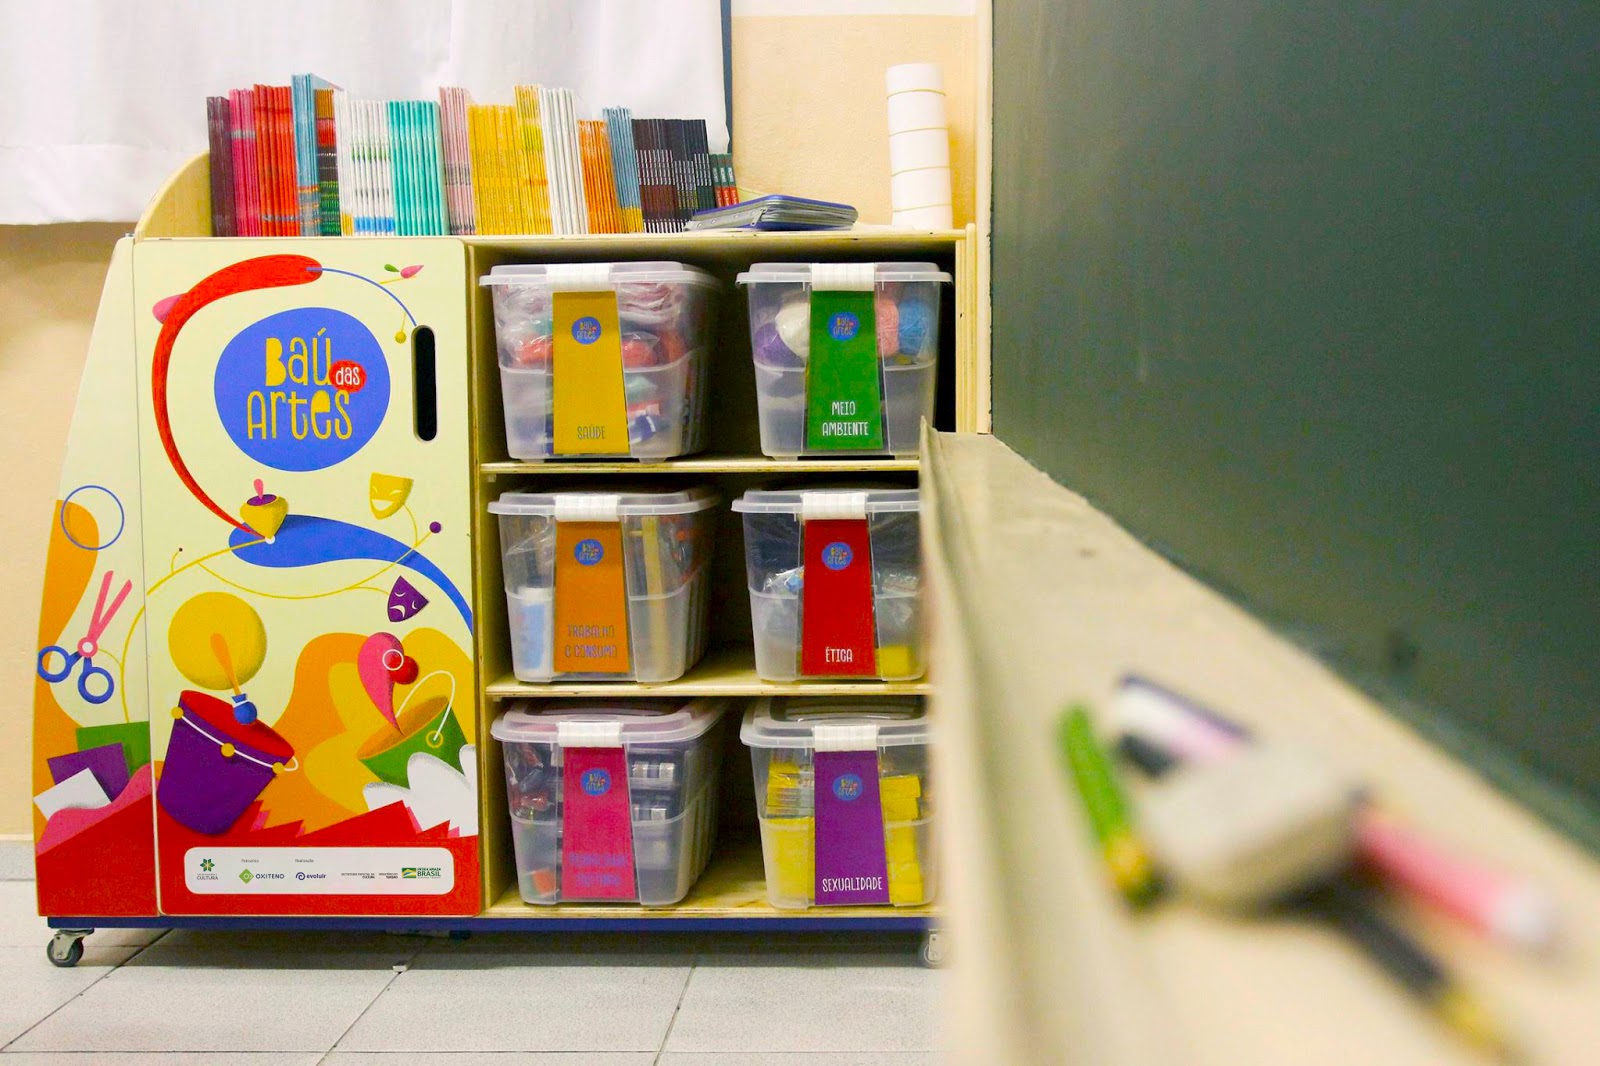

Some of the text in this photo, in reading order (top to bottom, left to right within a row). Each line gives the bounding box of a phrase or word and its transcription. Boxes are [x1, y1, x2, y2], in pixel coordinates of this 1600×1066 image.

[265, 328, 360, 386] Baú das
[247, 390, 353, 440] Artes
[832, 401, 856, 416] MEIO
[577, 424, 605, 439] SAÚDE
[822, 421, 869, 436] AMBIENTE
[568, 625, 614, 638] TRABALHO
[825, 646, 852, 662] ÉTICA
[822, 876, 882, 892] SEXUALIDADE
